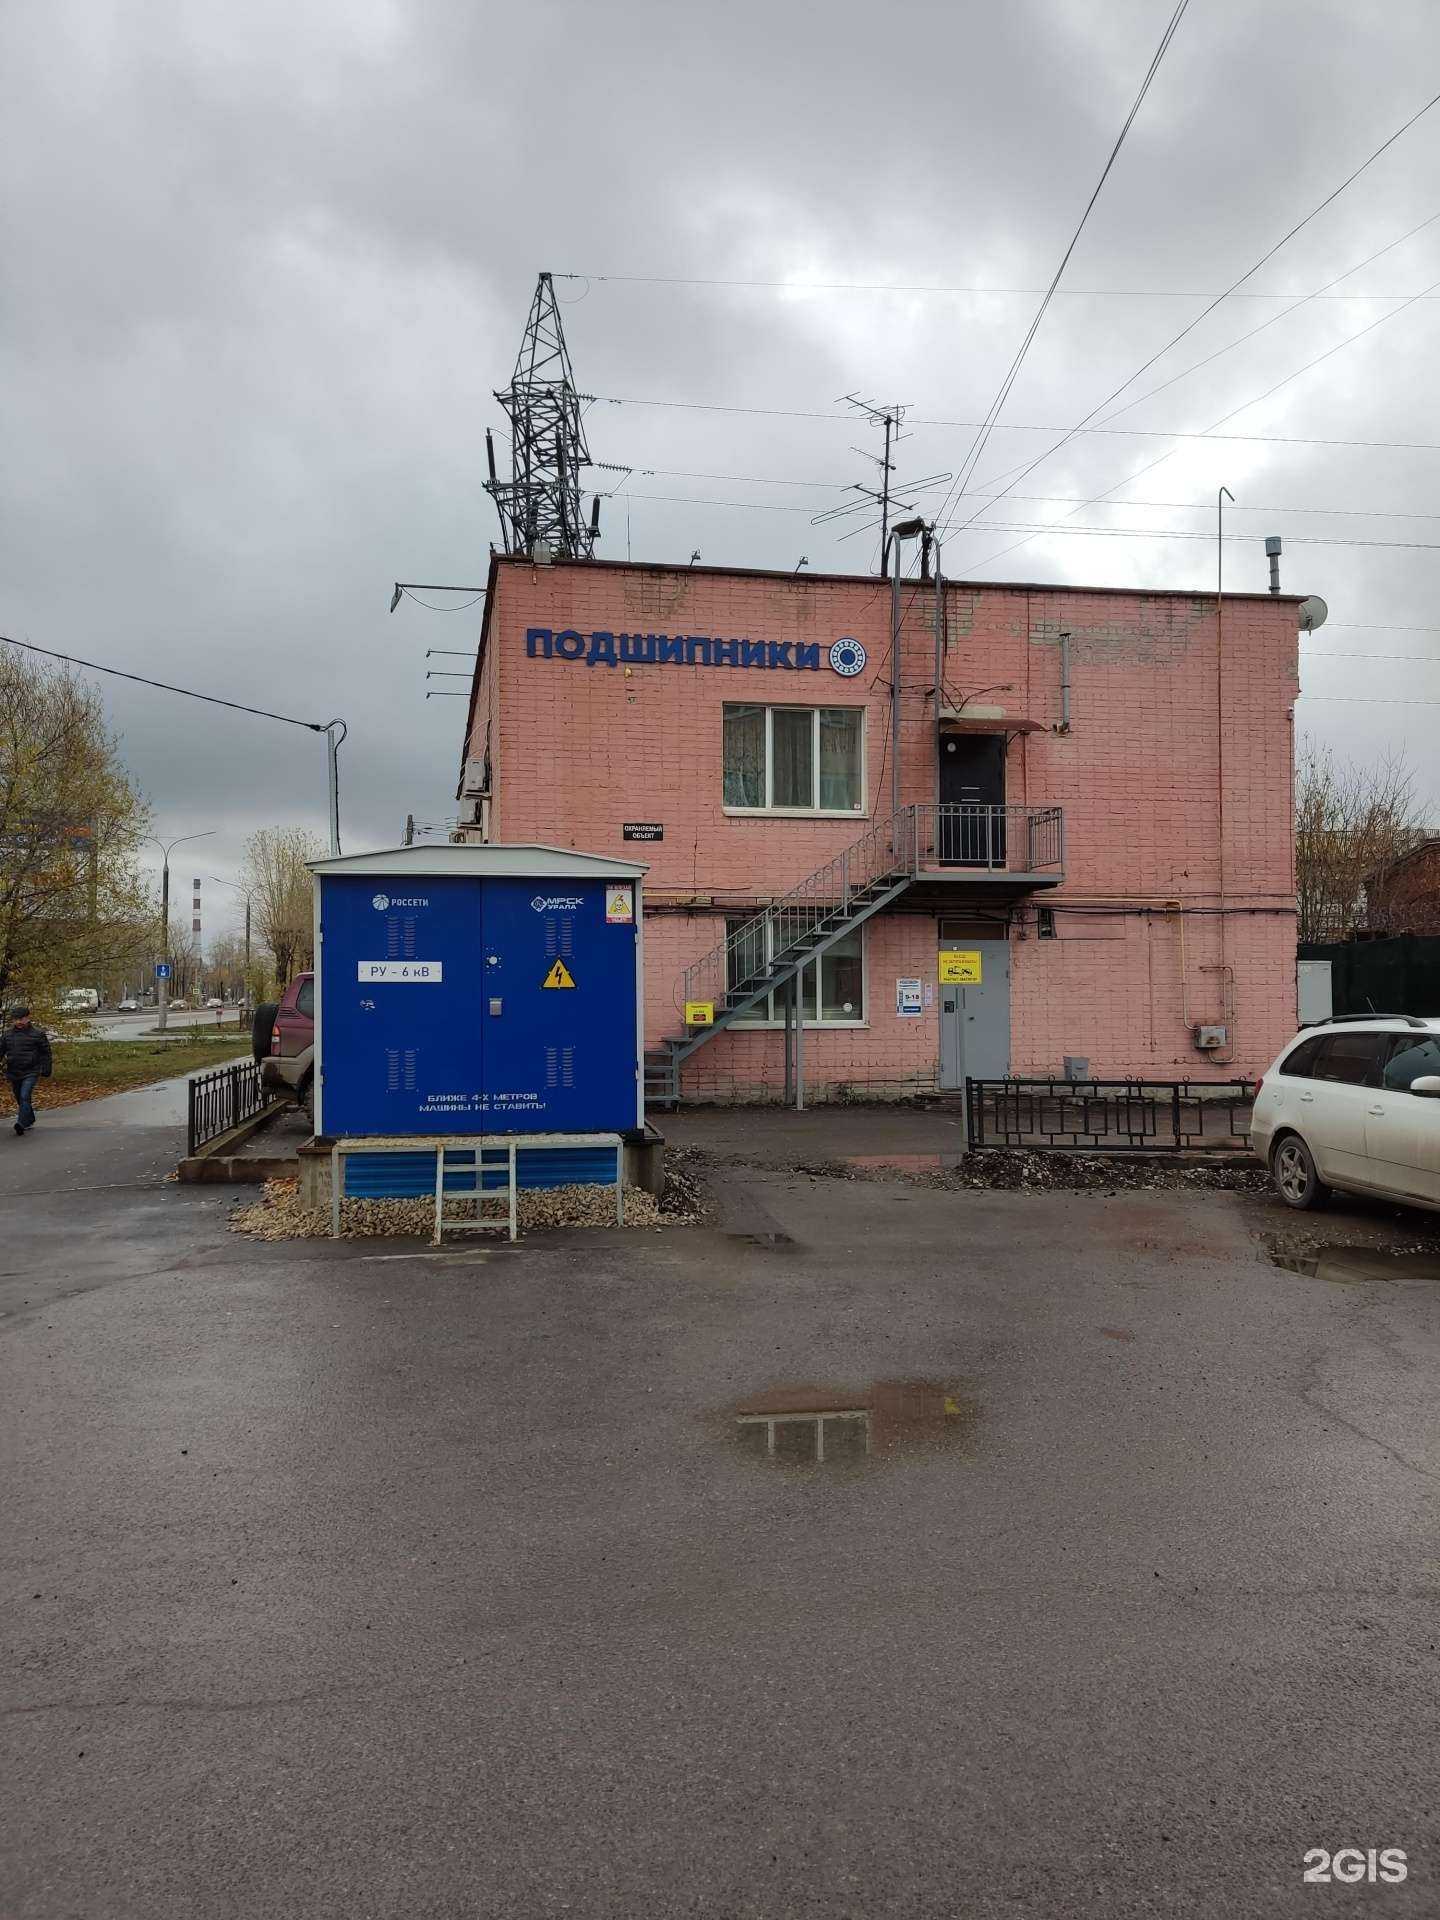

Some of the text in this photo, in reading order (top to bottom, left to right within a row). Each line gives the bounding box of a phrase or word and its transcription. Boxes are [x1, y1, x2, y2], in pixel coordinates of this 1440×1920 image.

[526, 628, 820, 671] ПОДШИПНИКИ
[391, 898, 429, 907] РОССЕТИ
[546, 897, 585, 905] МРСК
[370, 966, 387, 977] РУ
[402, 966, 409, 977] 6
[413, 966, 430, 977] кВ
[427, 1094, 467, 1102] БЛИЖЕ
[493, 1093, 538, 1101] МЕТРОВ
[418, 1102, 547, 1112] МАШИНЫ НЕ СТАВИТЬ!
